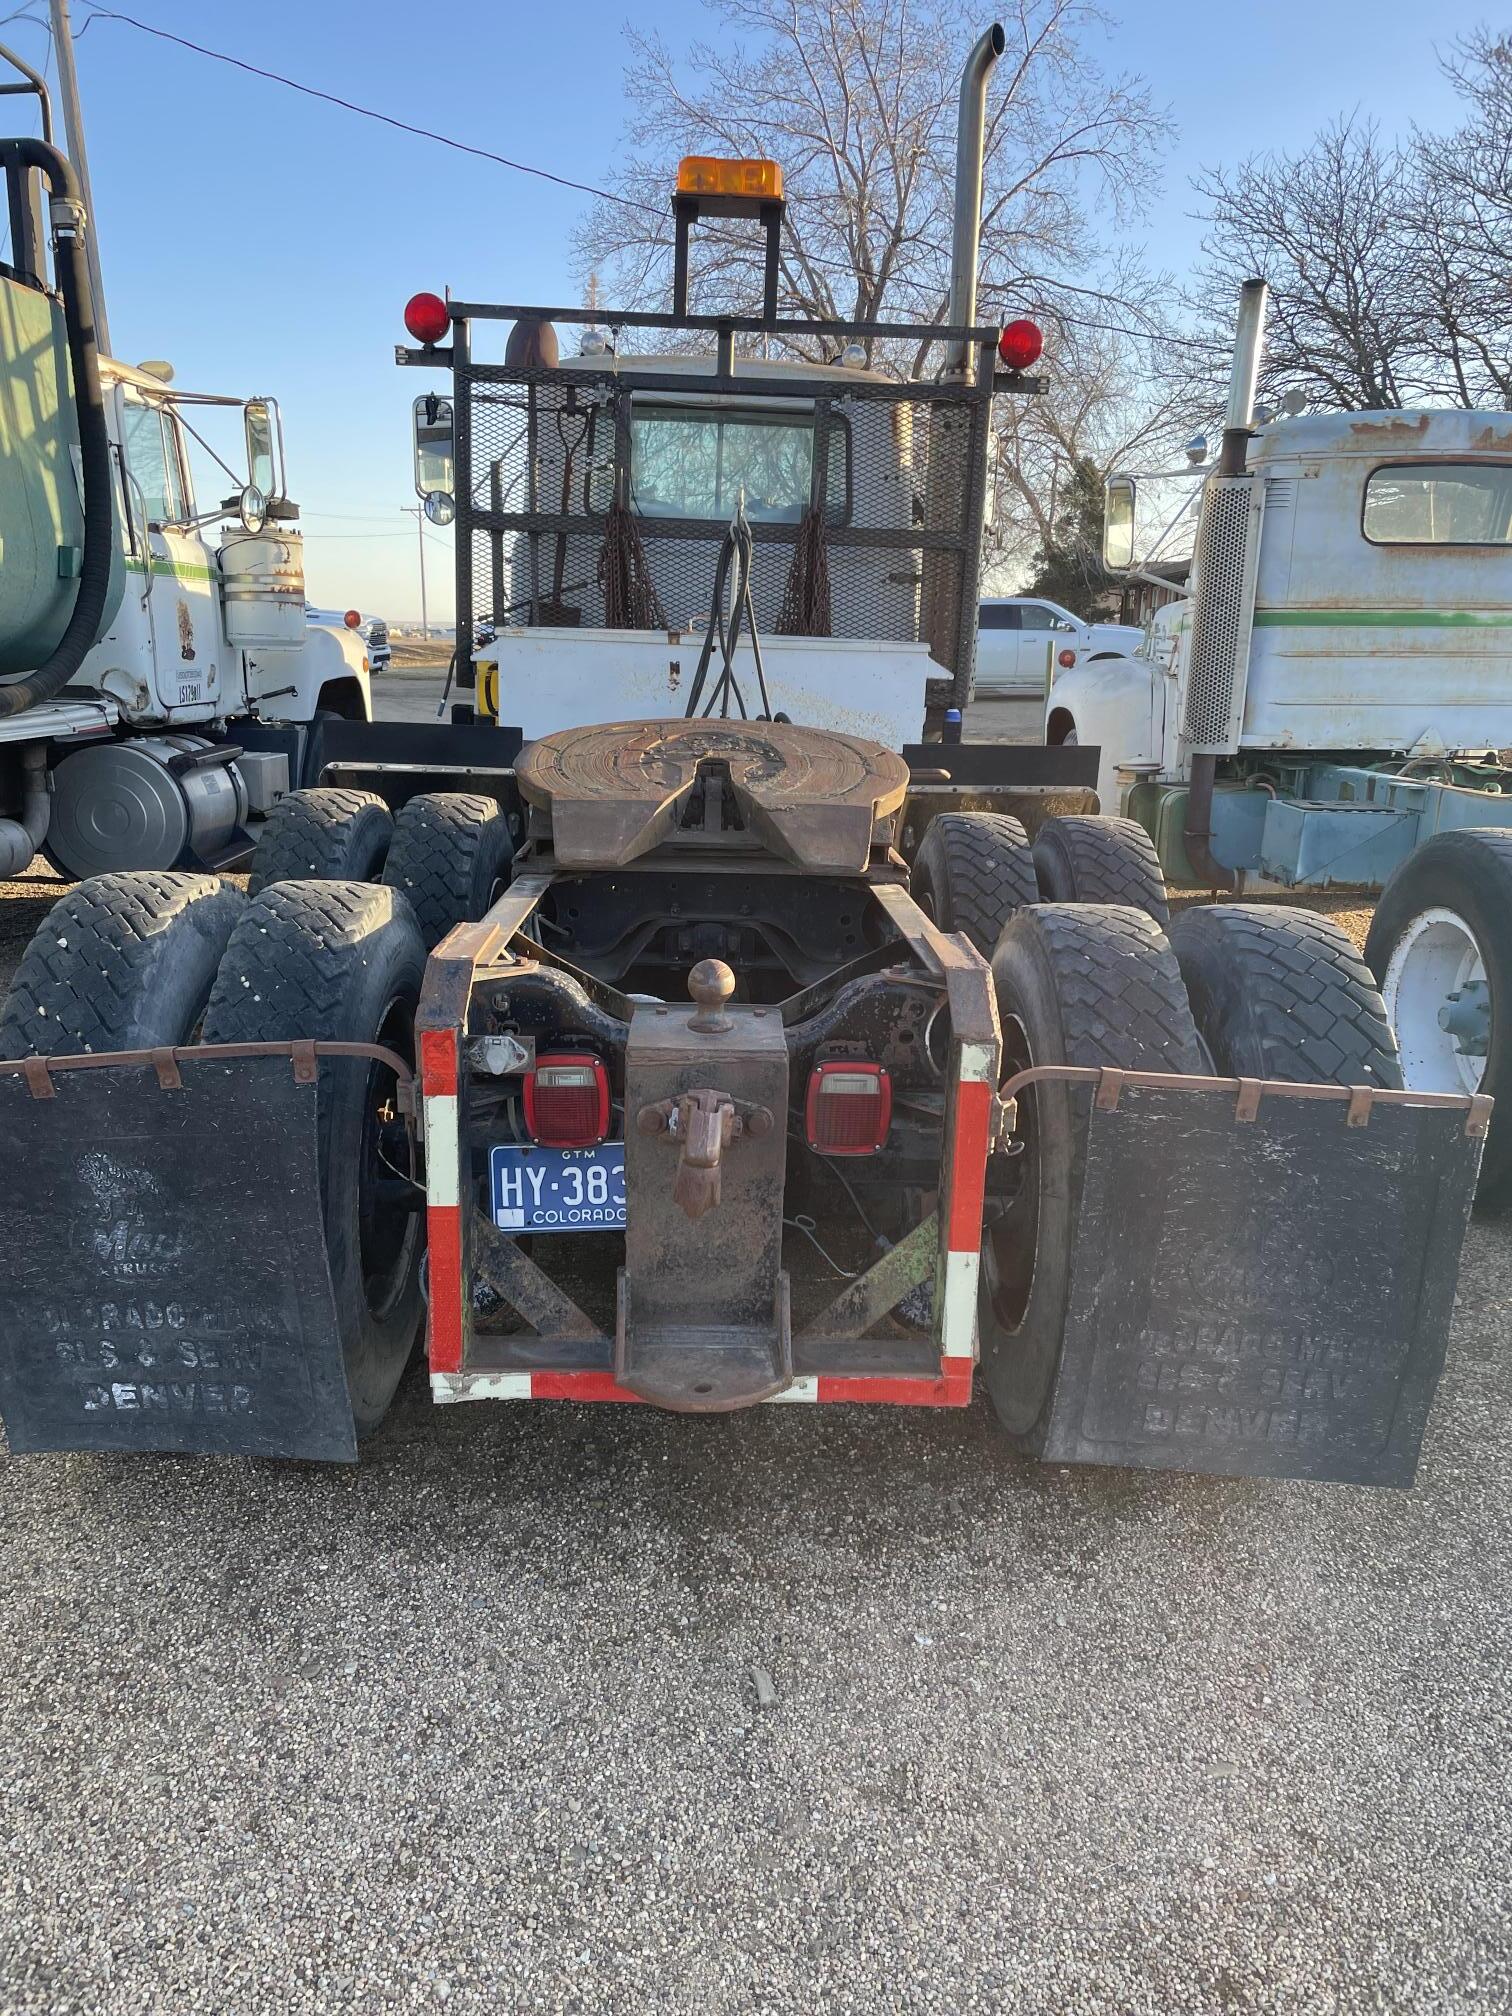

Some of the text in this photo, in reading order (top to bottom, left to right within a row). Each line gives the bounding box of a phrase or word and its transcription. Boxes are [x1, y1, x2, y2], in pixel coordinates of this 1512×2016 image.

[561, 1150, 596, 1160] GTM
[532, 1208, 627, 1224] COLORADO
[83, 1382, 254, 1413] DENVER
